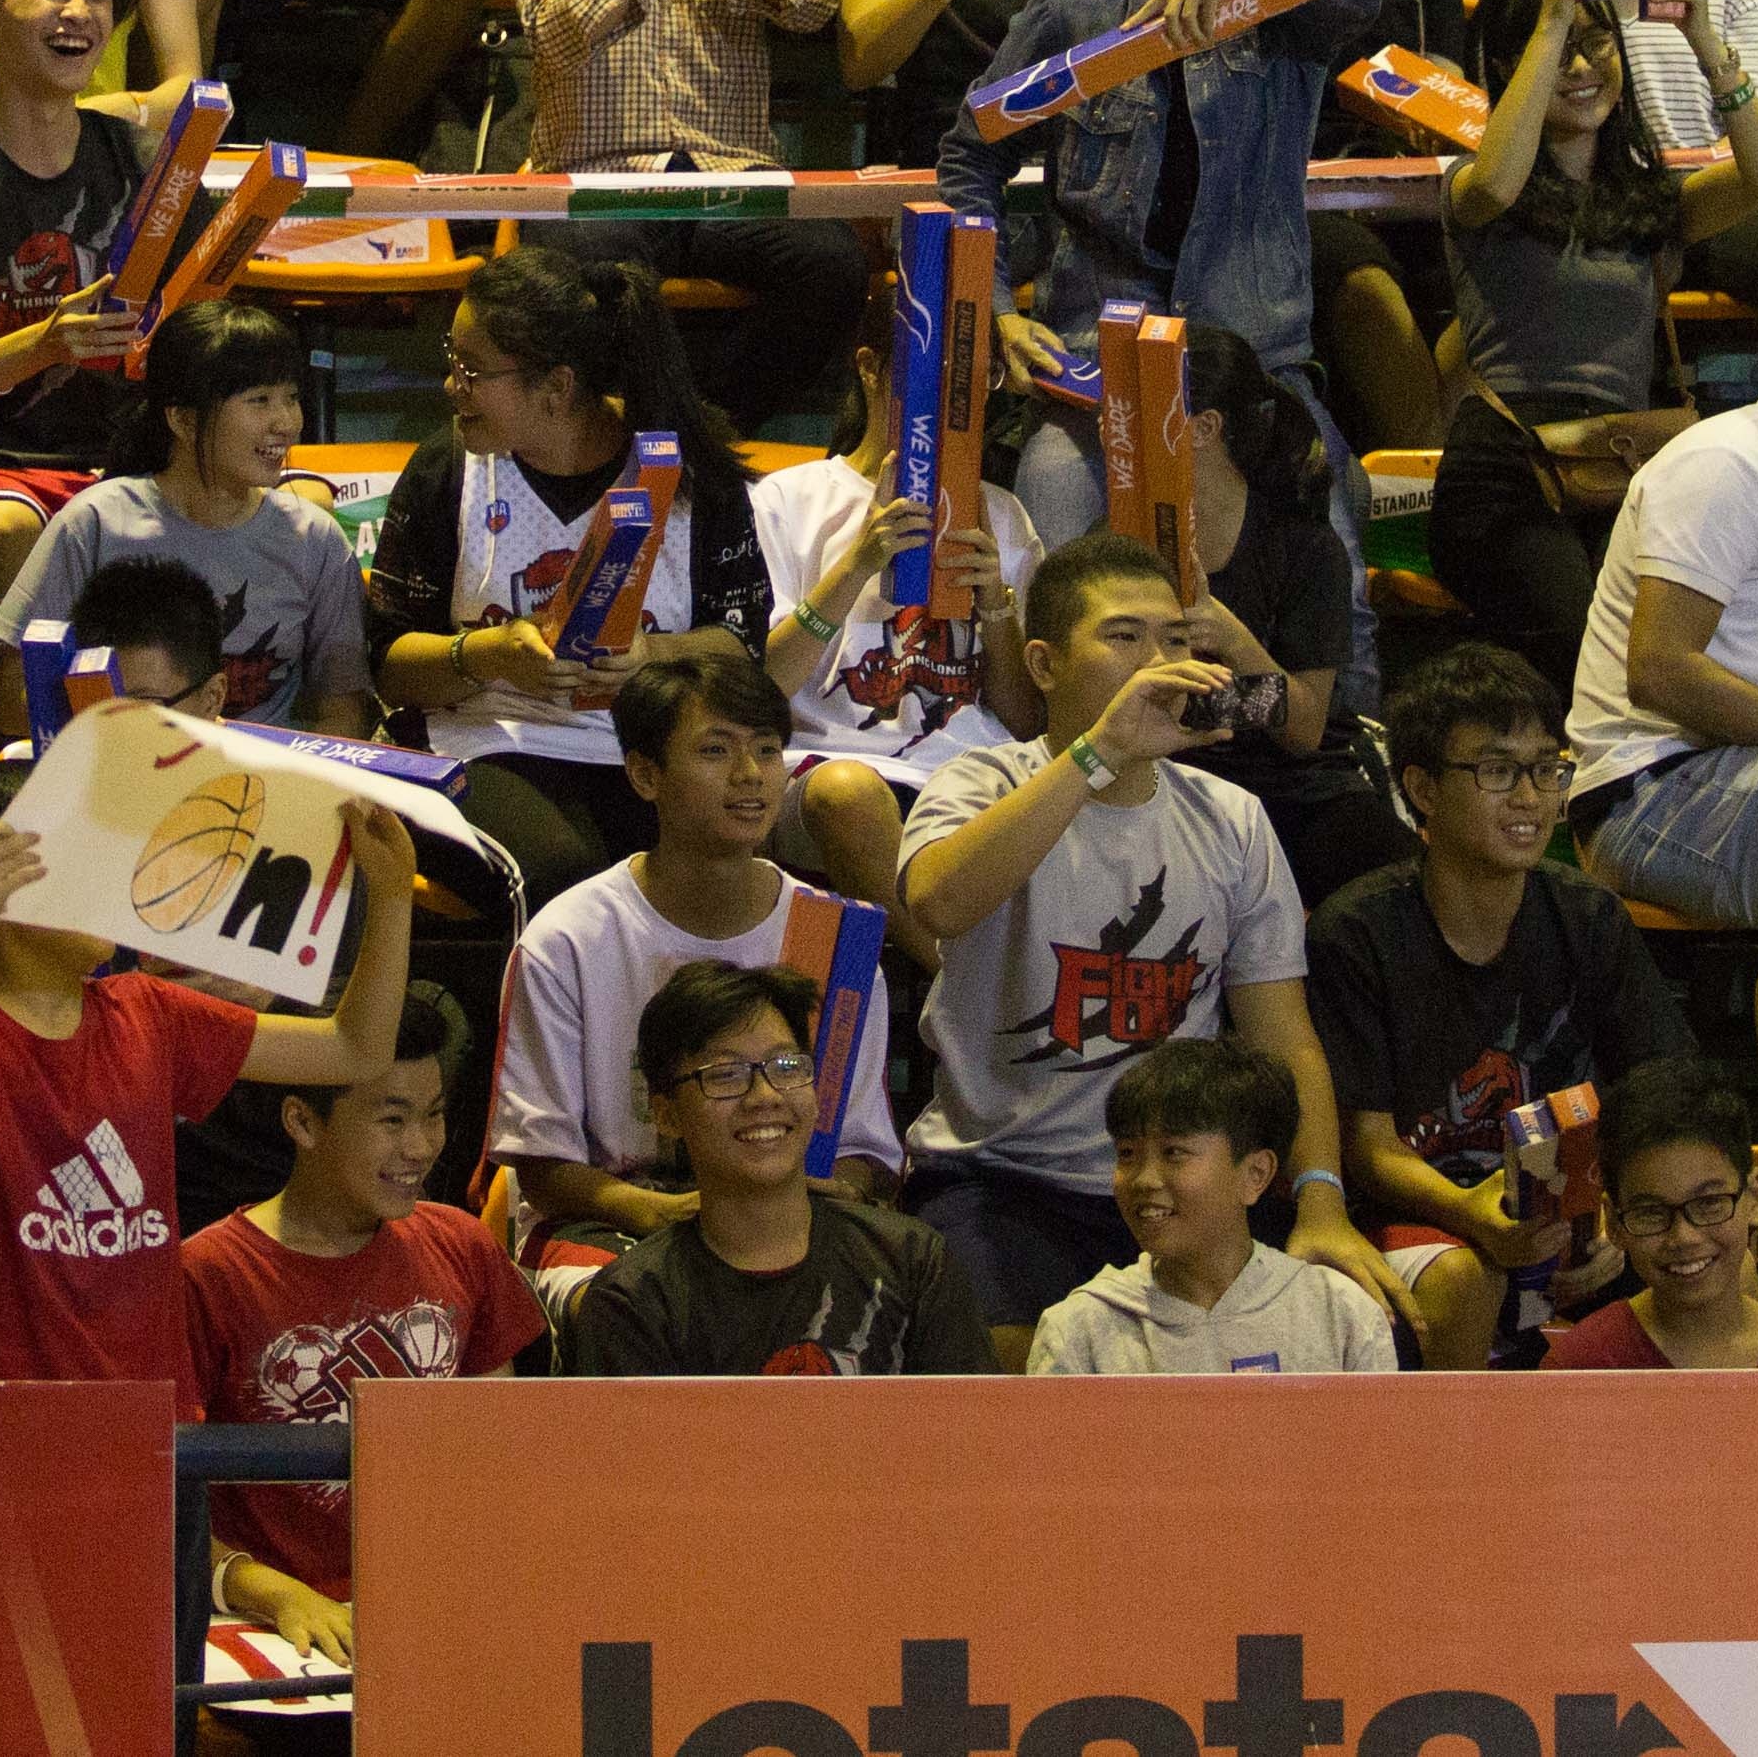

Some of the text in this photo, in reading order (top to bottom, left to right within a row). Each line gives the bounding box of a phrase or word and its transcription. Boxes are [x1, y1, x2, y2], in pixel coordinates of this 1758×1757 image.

[145, 165, 195, 240] WE DARE
[912, 414, 932, 454] WE
[1107, 393, 1135, 491] WE DARE
[288, 736, 383, 767] WE DARE
[18, 1207, 170, 1258] adidas
